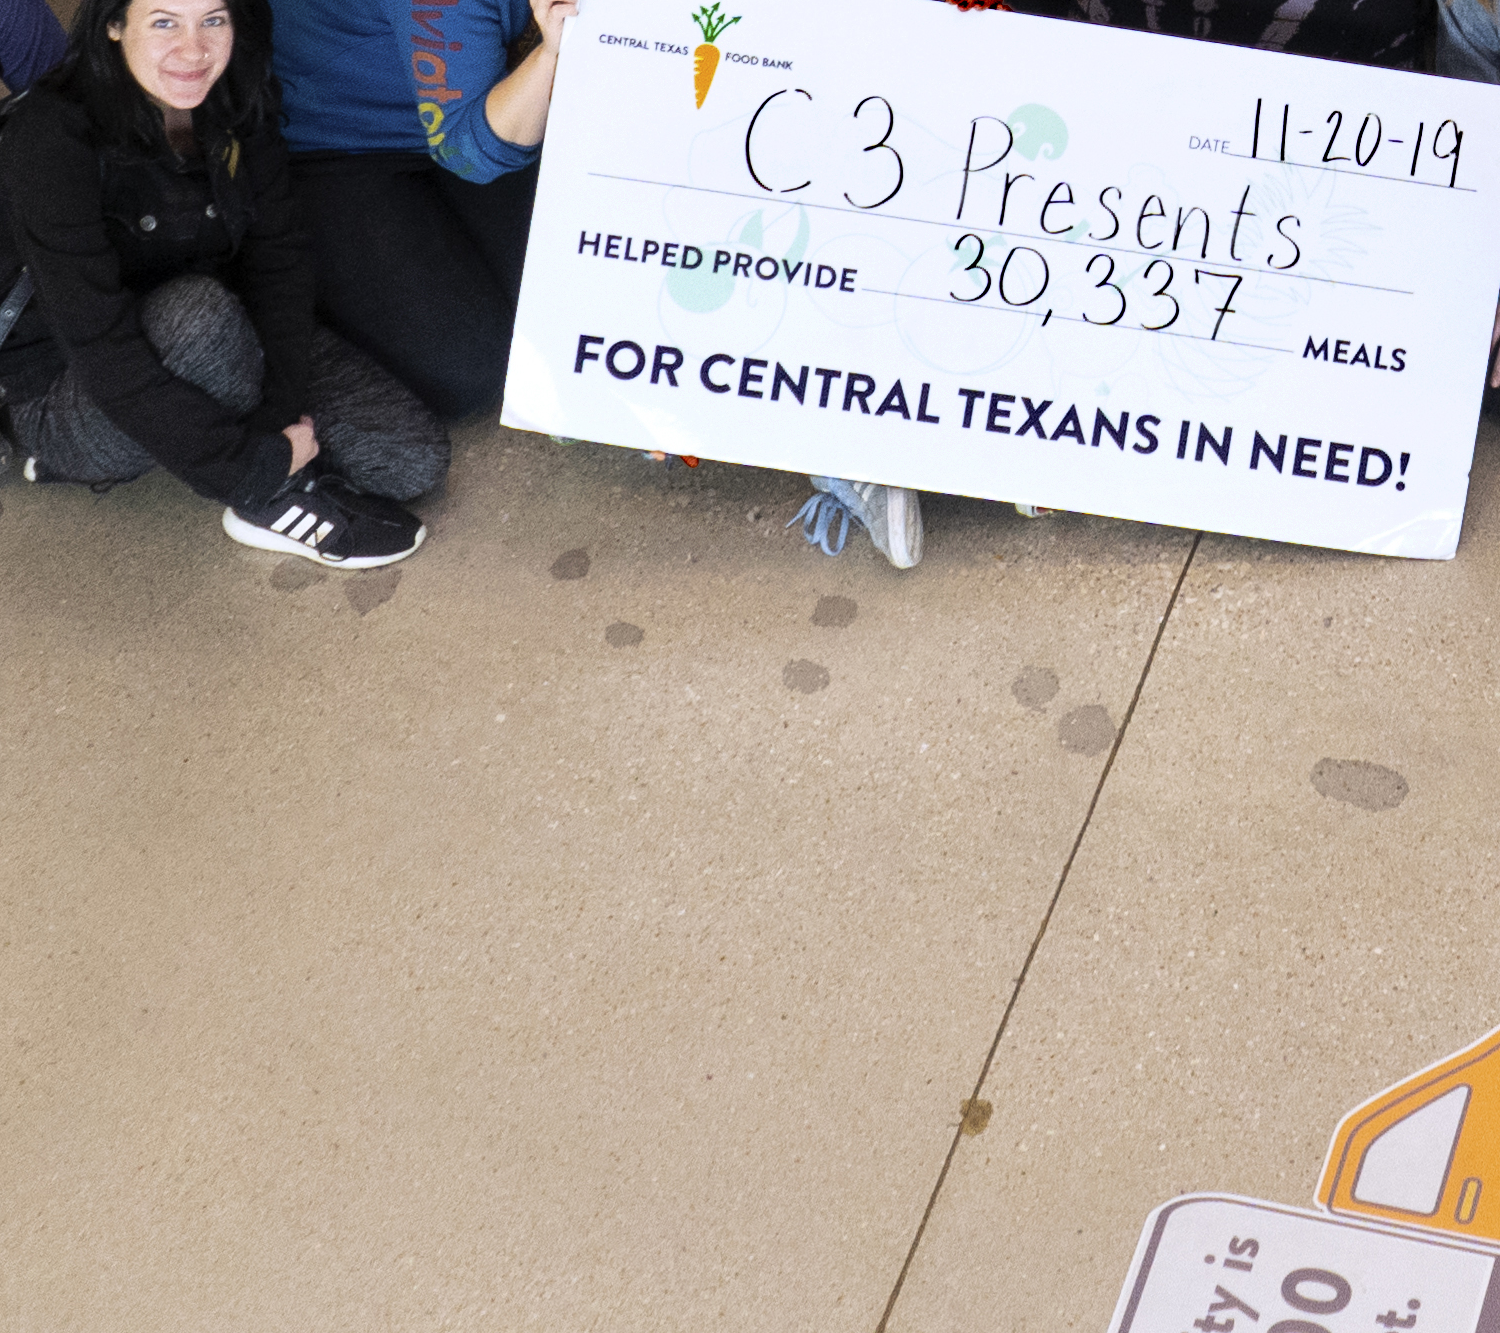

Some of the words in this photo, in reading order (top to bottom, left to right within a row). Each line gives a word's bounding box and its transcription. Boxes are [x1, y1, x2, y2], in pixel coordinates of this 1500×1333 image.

[598, 33, 649, 50] CENTRAL
[653, 40, 689, 55] TEXAS
[724, 51, 759, 66] FOOD
[762, 56, 794, 71] BANK
[1188, 134, 1231, 155] DATE
[1251, 98, 1465, 189] 11-20-19
[956, 116, 1302, 270] Presents
[577, 230, 703, 270] HELPED
[712, 249, 858, 293] PROVIDE
[948, 233, 1243, 342] 30,337
[1302, 335, 1408, 373] MEALS
[572, 333, 685, 389] FOR
[698, 352, 941, 425] CENTRAL
[957, 387, 1162, 455] TEXANS
[1175, 419, 1233, 467] IN
[1248, 429, 1412, 492] NEED!
[1203, 1234, 1260, 1273] is
[1182, 1284, 1260, 1333] ty
